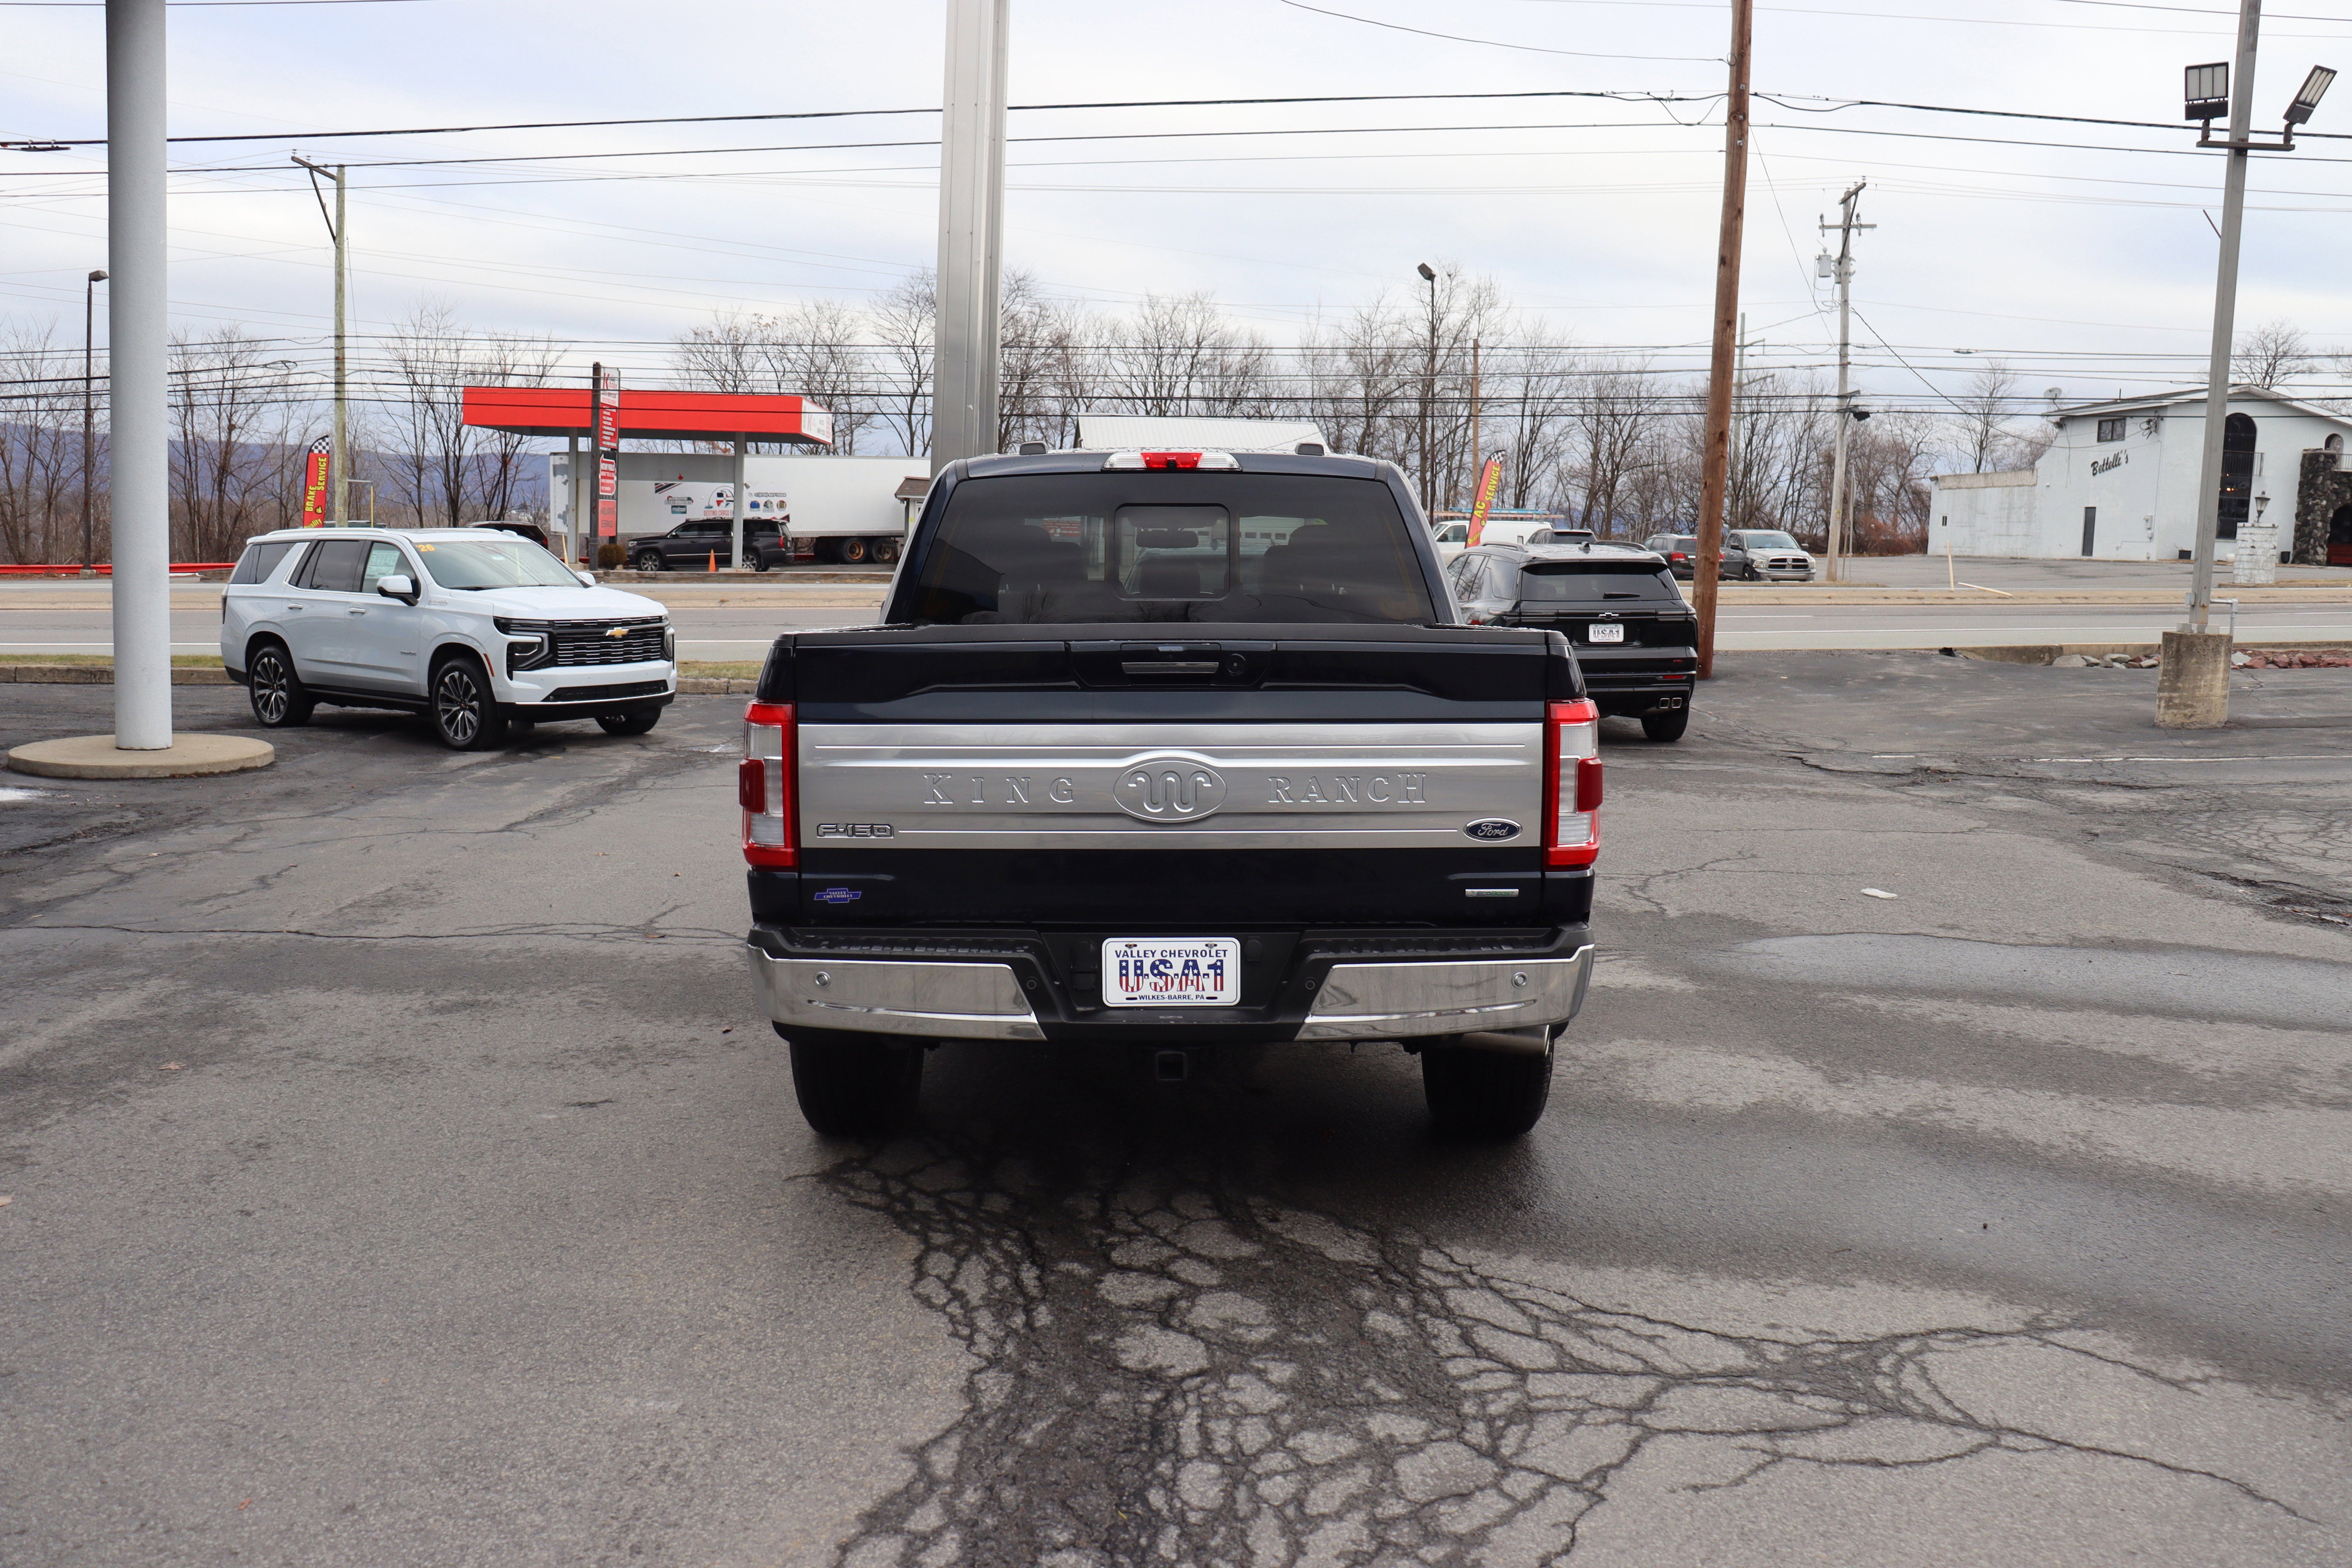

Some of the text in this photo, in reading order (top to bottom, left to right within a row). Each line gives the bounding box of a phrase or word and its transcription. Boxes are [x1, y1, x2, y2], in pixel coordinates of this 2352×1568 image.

[317, 457, 327, 491] SERVICE
[2091, 450, 2129, 476] Bettelli's
[1485, 465, 1501, 501] SERVICE
[305, 485, 317, 512] BRAKE
[1473, 500, 1486, 519] AC
[924, 772, 1426, 804] KING RANCH
[817, 823, 894, 839] F-150
[1477, 823, 1509, 836] Ford
[1115, 949, 1228, 958] VALLEY CHEVROLET
